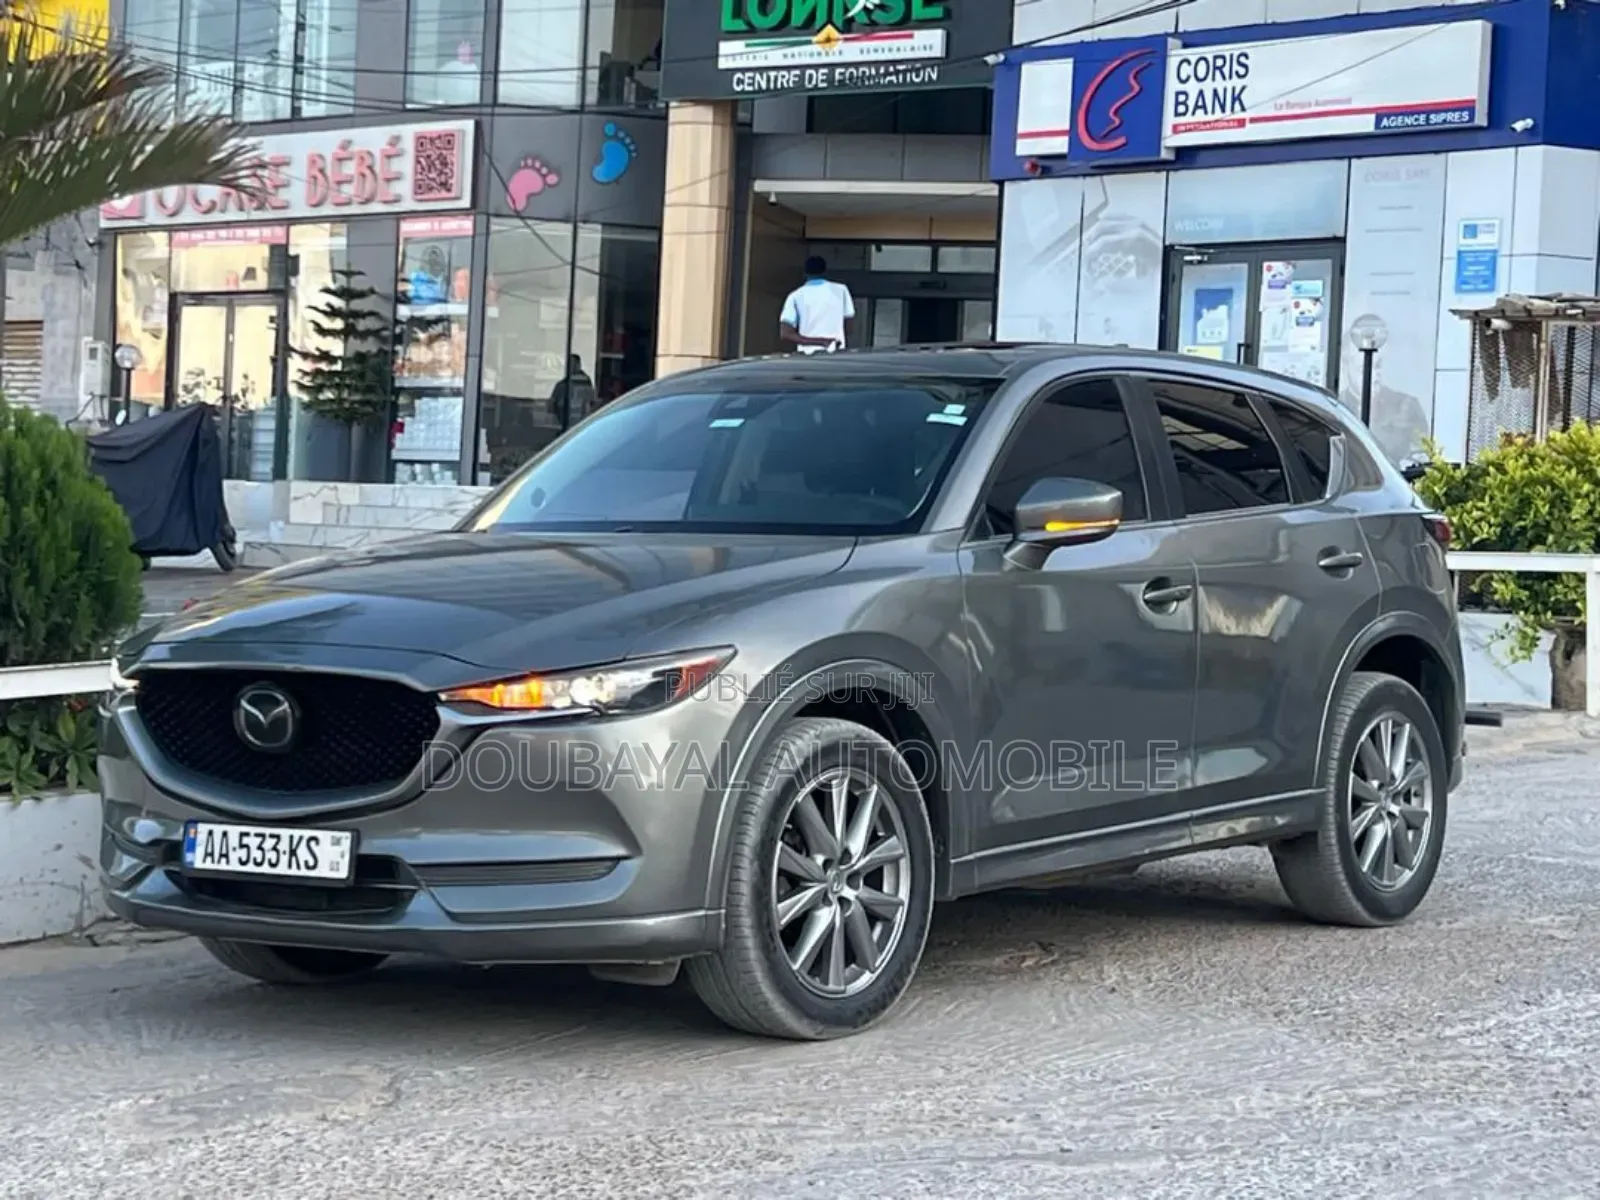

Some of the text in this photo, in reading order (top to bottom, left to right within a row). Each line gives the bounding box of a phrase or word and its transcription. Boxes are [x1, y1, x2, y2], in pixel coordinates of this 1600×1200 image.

[732, 64, 938, 91] CENTRE DE FORMATION
[1176, 52, 1250, 84] CORIS
[1174, 85, 1247, 118] BANK
[1380, 110, 1470, 128] AGENCE SIPRES
[306, 134, 404, 208] BÉBÉ
